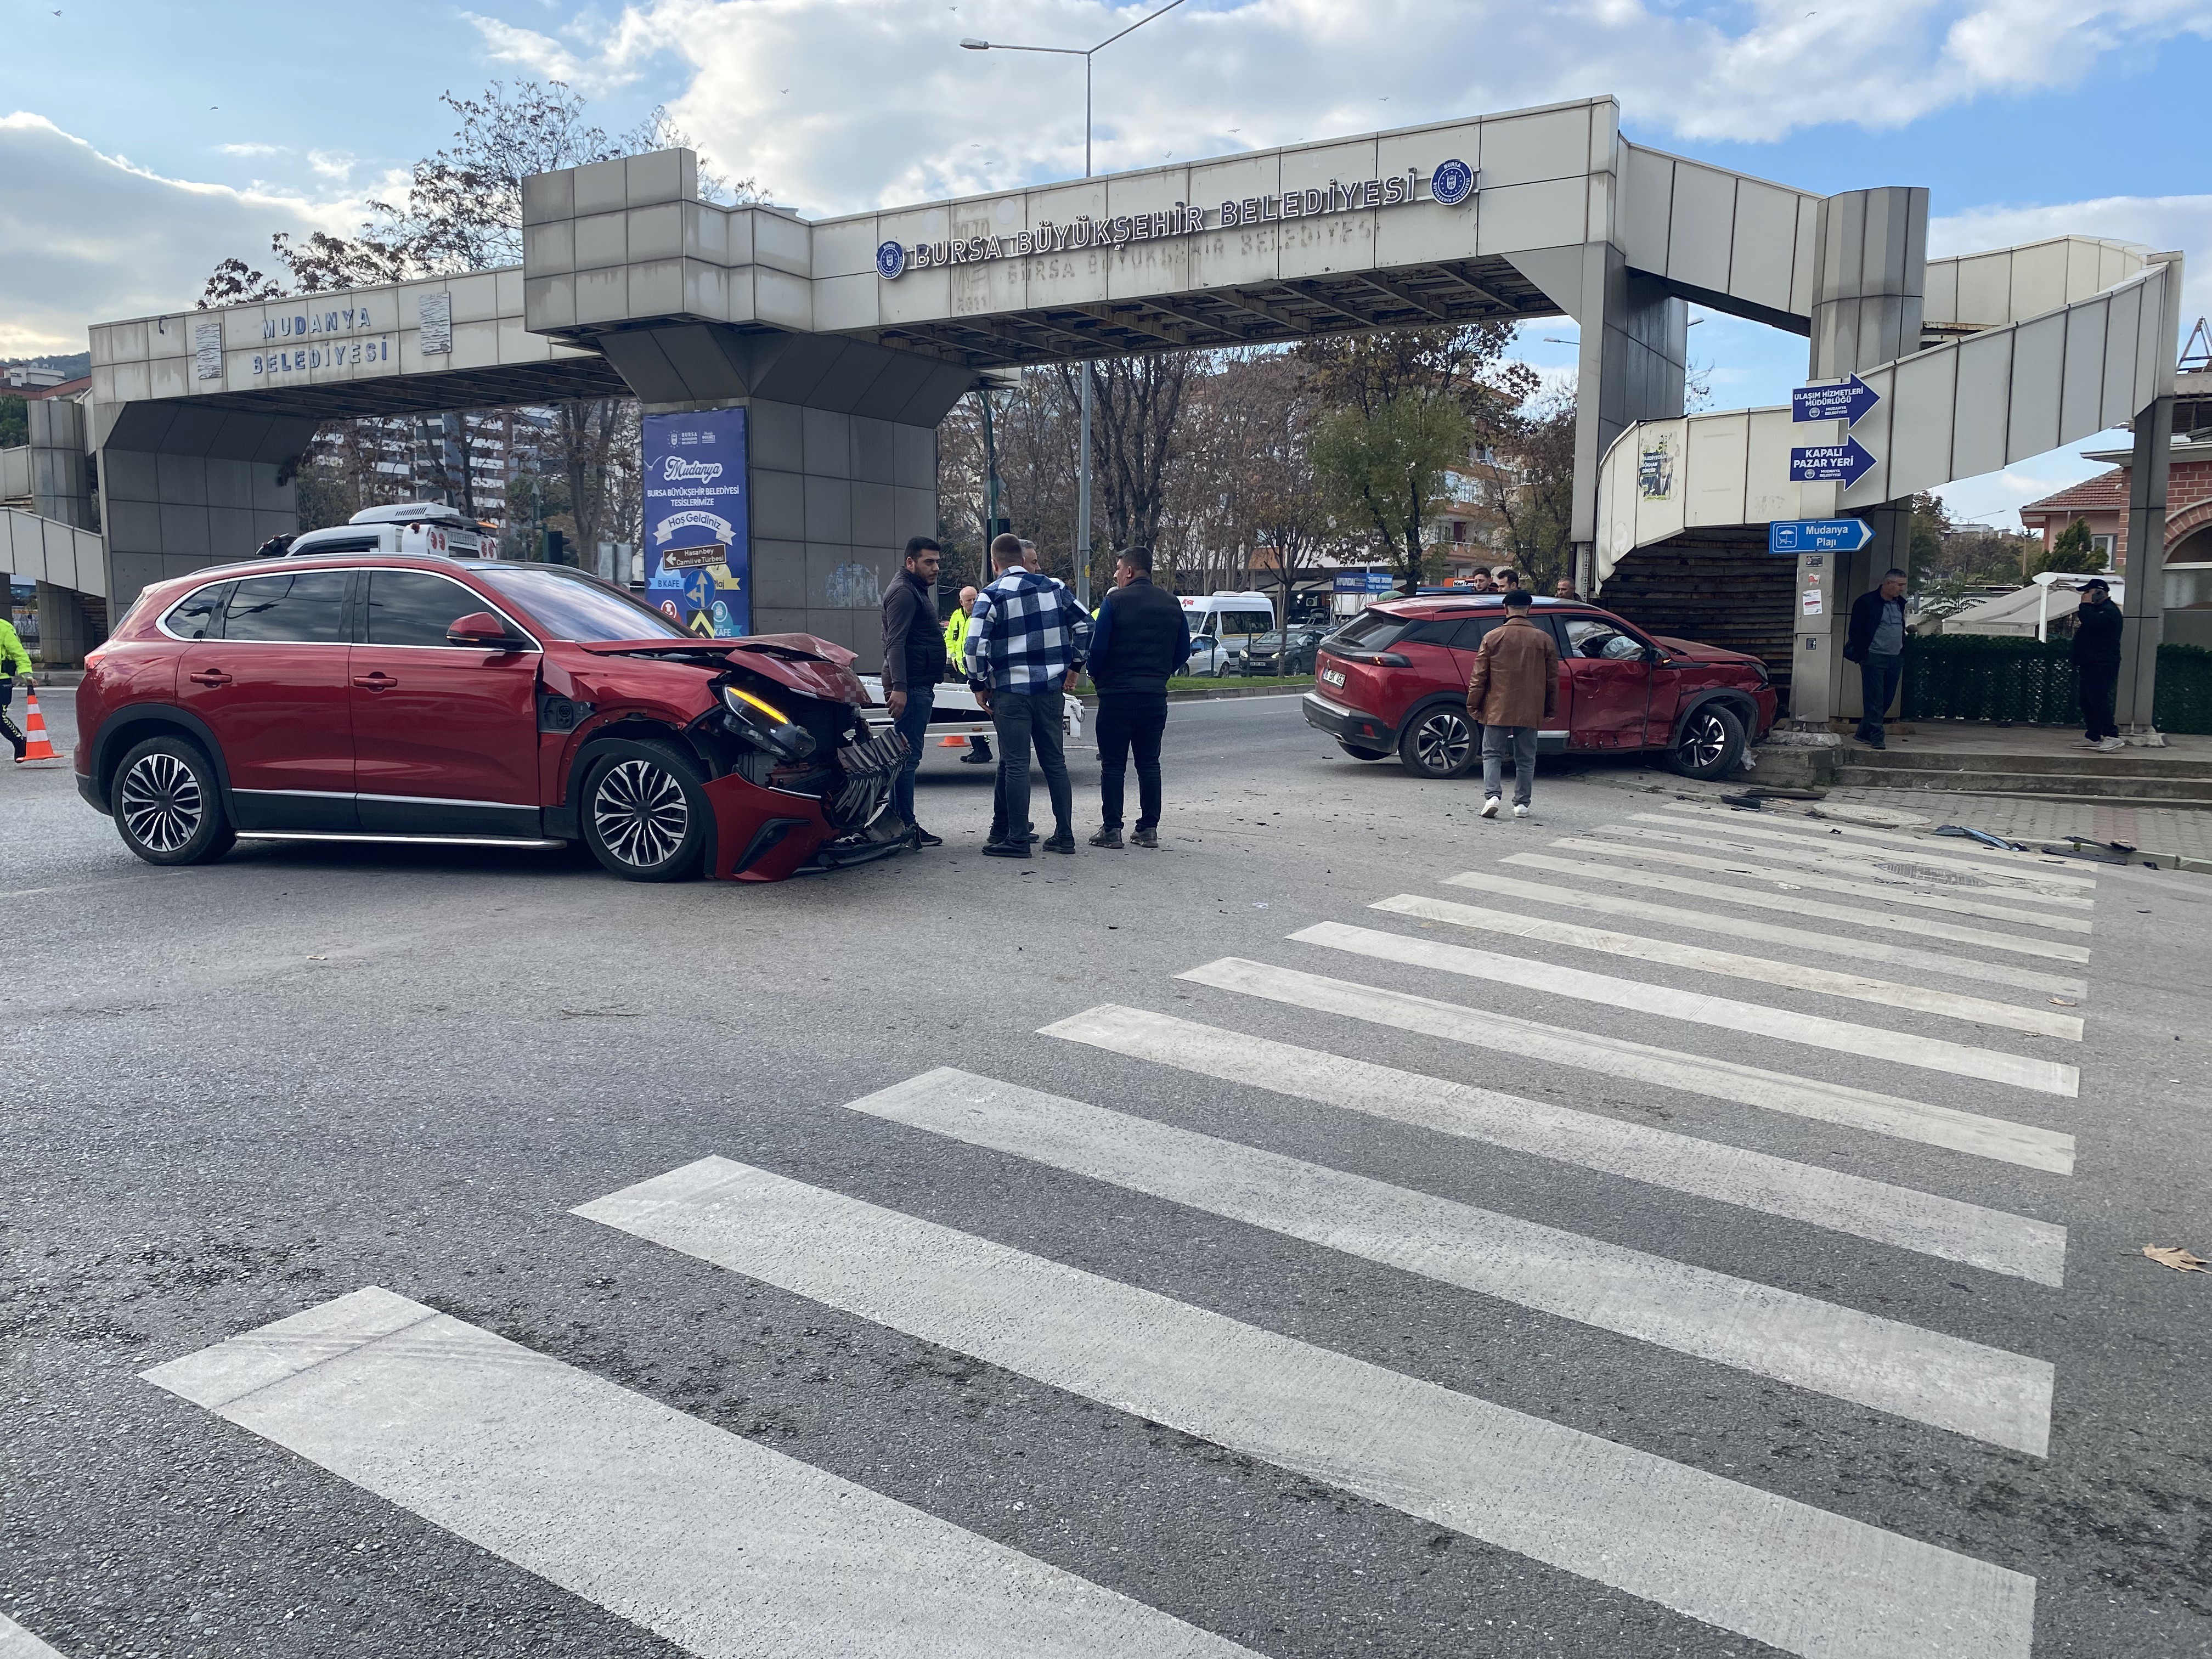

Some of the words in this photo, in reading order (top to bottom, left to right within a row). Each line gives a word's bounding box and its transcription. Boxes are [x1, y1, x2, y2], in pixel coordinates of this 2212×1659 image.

[915, 234, 1002, 268] BURSA
[1017, 201, 1204, 255] BÜYÜKŞEHİR
[1220, 167, 1417, 228] BELEDİYESİ
[263, 308, 371, 339] MUDANYA
[253, 334, 387, 375] BELEDİYESİ
[1794, 391, 1821, 401] ULAŞIM
[1822, 386, 1864, 398] HİZMETLERİ
[1805, 395, 1852, 407] MÜDÜRLÜĞÜ
[1805, 448, 1843, 458] KAPALI
[1793, 458, 1827, 468] PAZAR
[1830, 455, 1854, 467] YERİ
[664, 457, 721, 483] Mudanya
[667, 486, 705, 498] BÜYÜKŞEHİR
[706, 485, 739, 495] BELEDİYESİ
[670, 496, 714, 507] TESİSLERİMİZE
[668, 516, 685, 528] Hoş
[686, 513, 721, 530] Geldiniz
[1805, 525, 1848, 535] Mudanya
[1816, 537, 1836, 548] Plajı
[714, 628, 731, 636] KAFE
